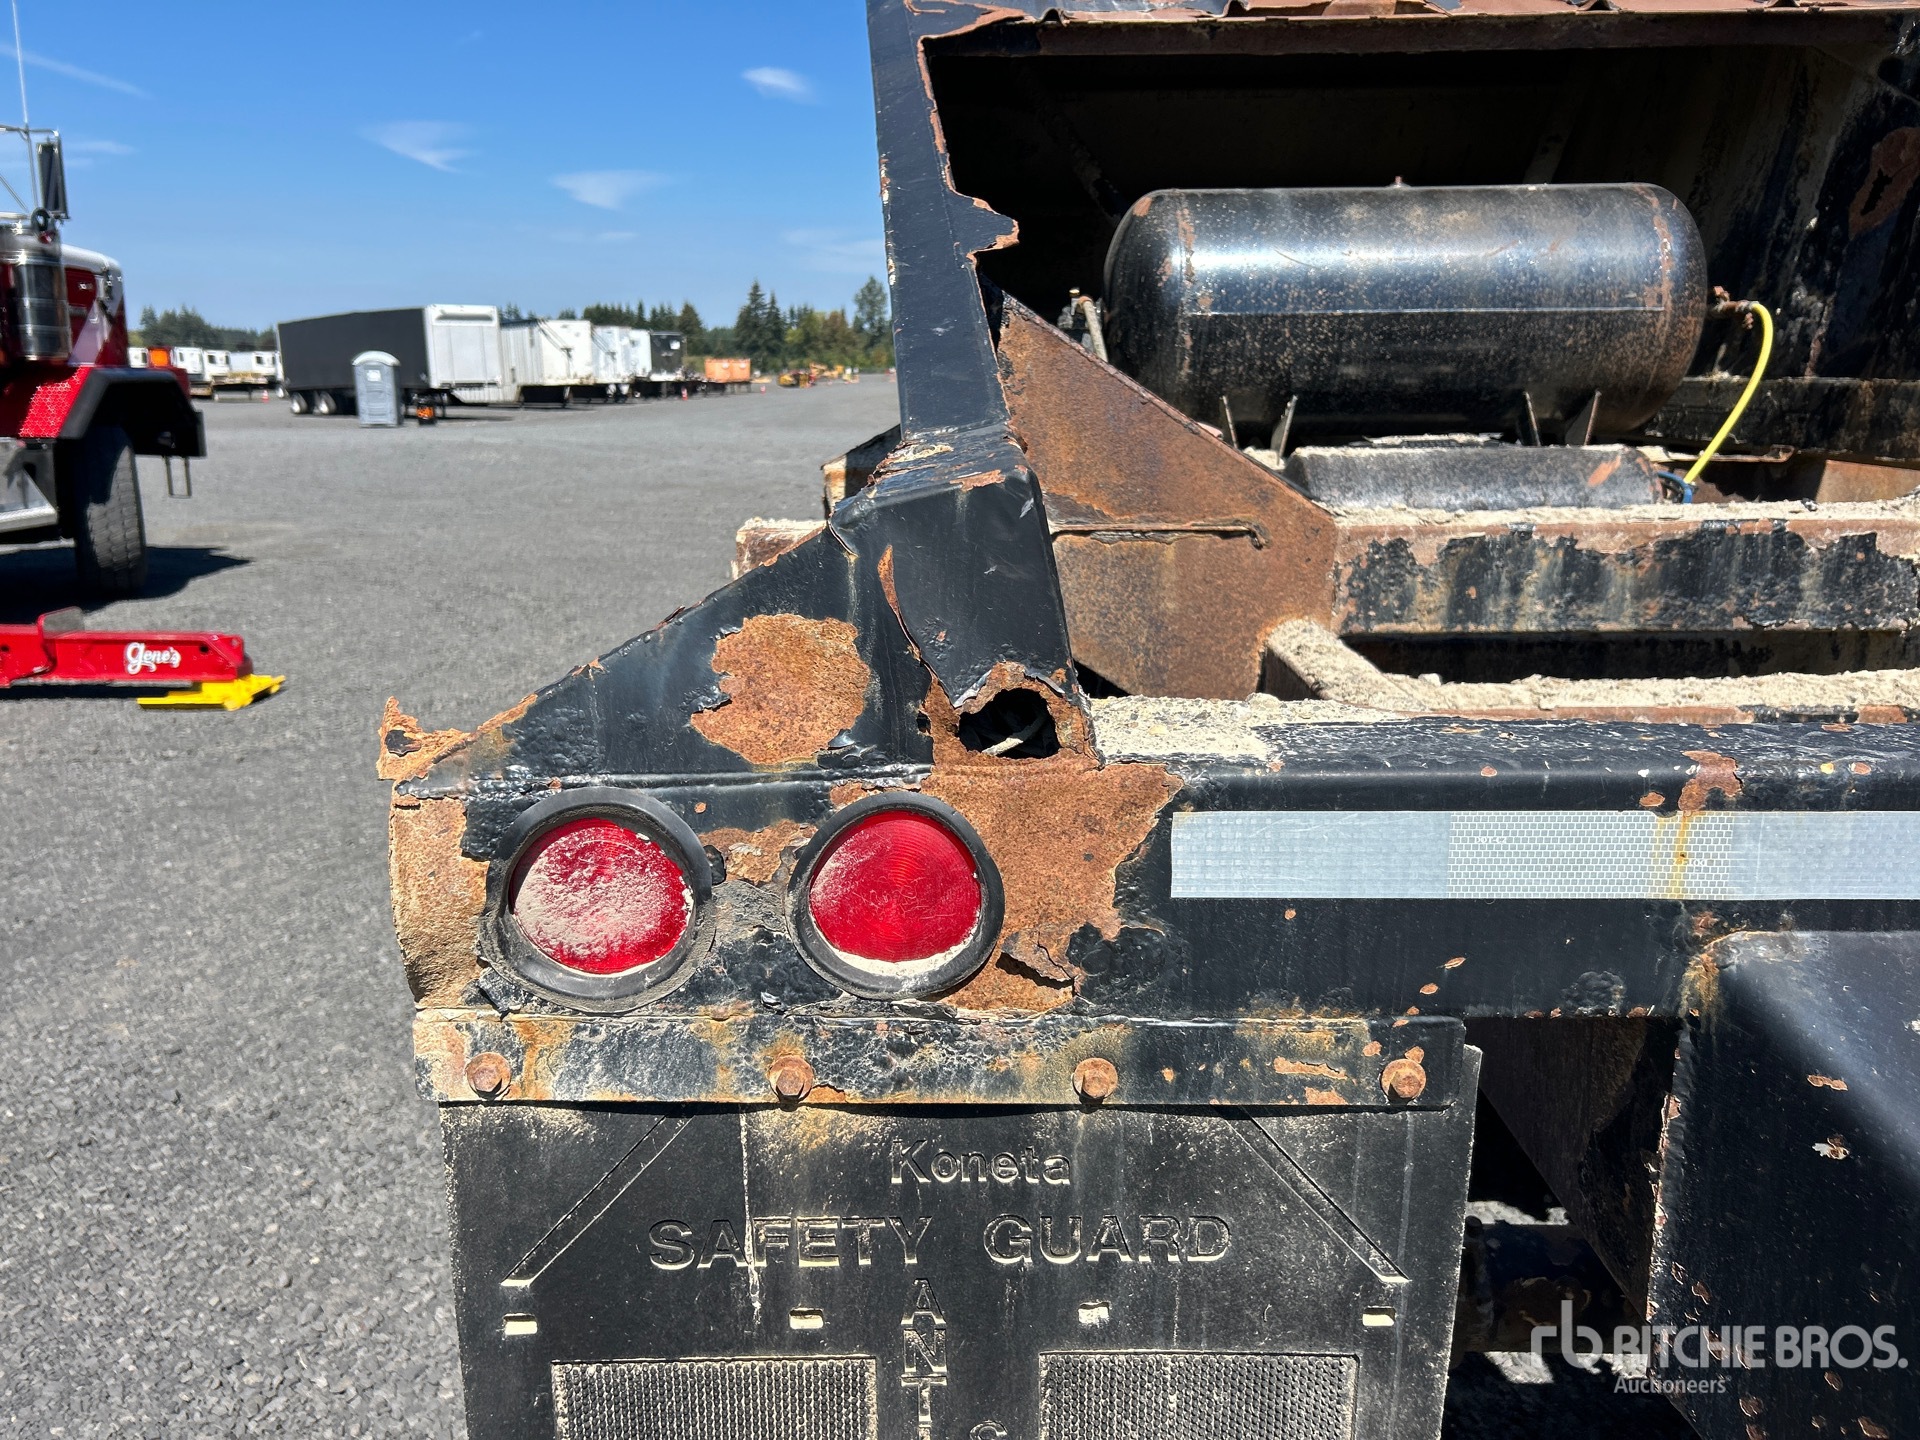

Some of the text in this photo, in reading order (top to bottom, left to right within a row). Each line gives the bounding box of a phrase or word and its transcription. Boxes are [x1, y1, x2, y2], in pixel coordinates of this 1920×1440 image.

[890, 1139, 1072, 1185] Koneta
[649, 1213, 1232, 1270] SAFETY GUARD
